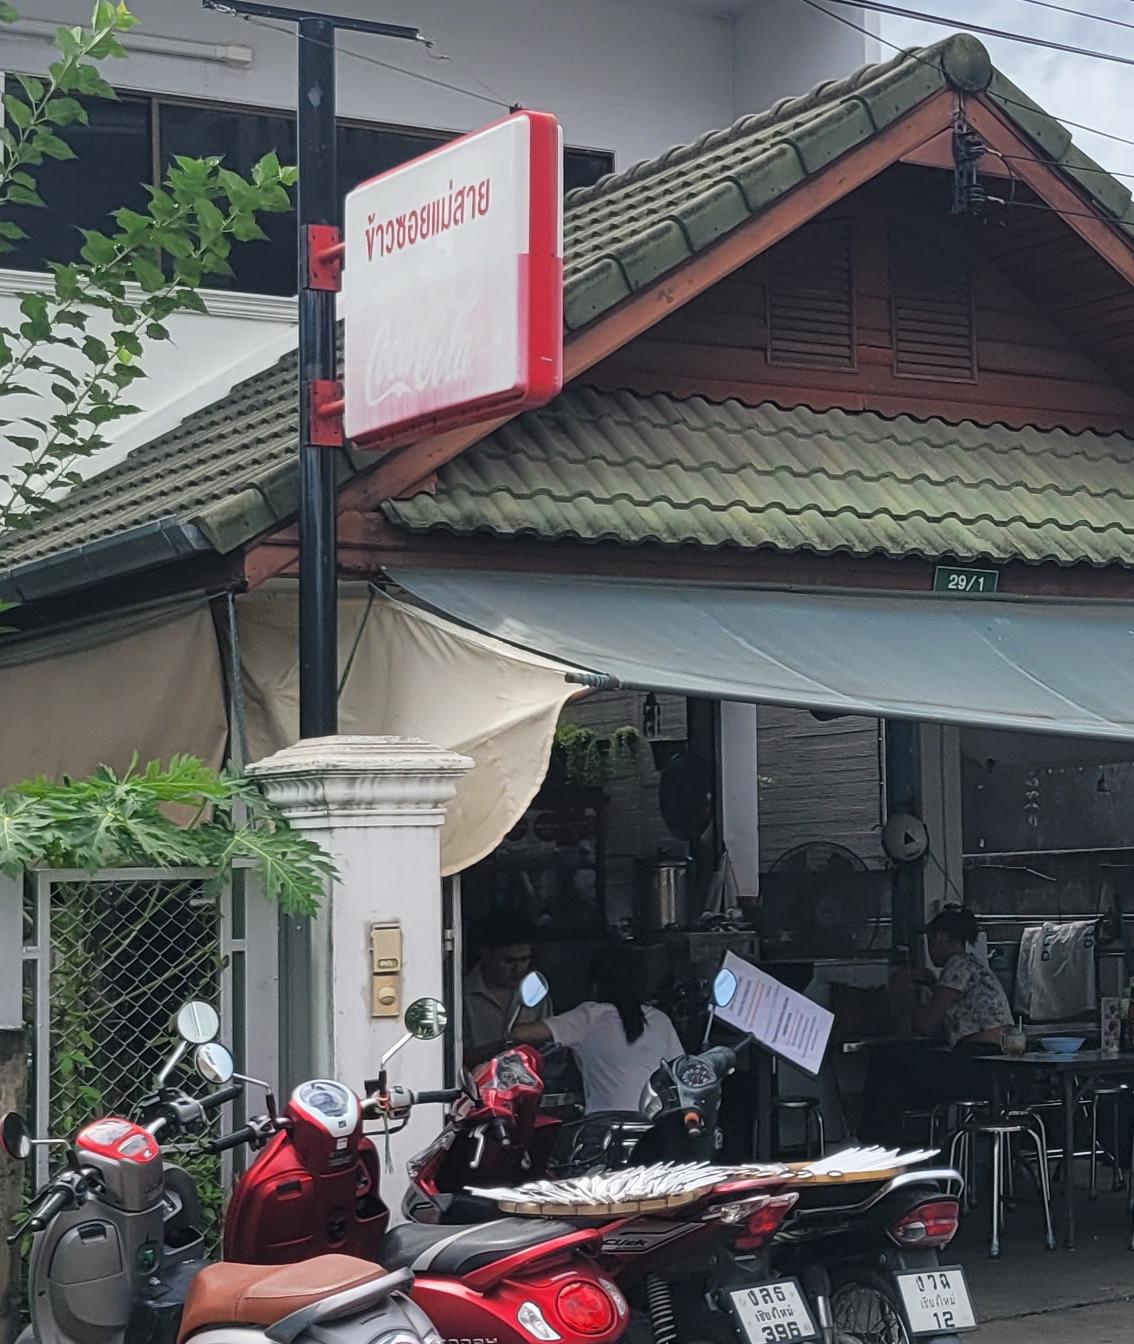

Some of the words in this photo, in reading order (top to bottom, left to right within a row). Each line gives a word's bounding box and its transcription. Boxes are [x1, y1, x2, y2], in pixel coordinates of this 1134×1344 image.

[365, 178, 491, 263] ข้าวซอยแม่สาย
[947, 574, 985, 592] 29/1
[920, 1293, 957, 1309] เชียงใหม่
[755, 1304, 794, 1322] เชียงใหม่
[932, 1310, 956, 1329] 12
[761, 1321, 803, 1344] 396
